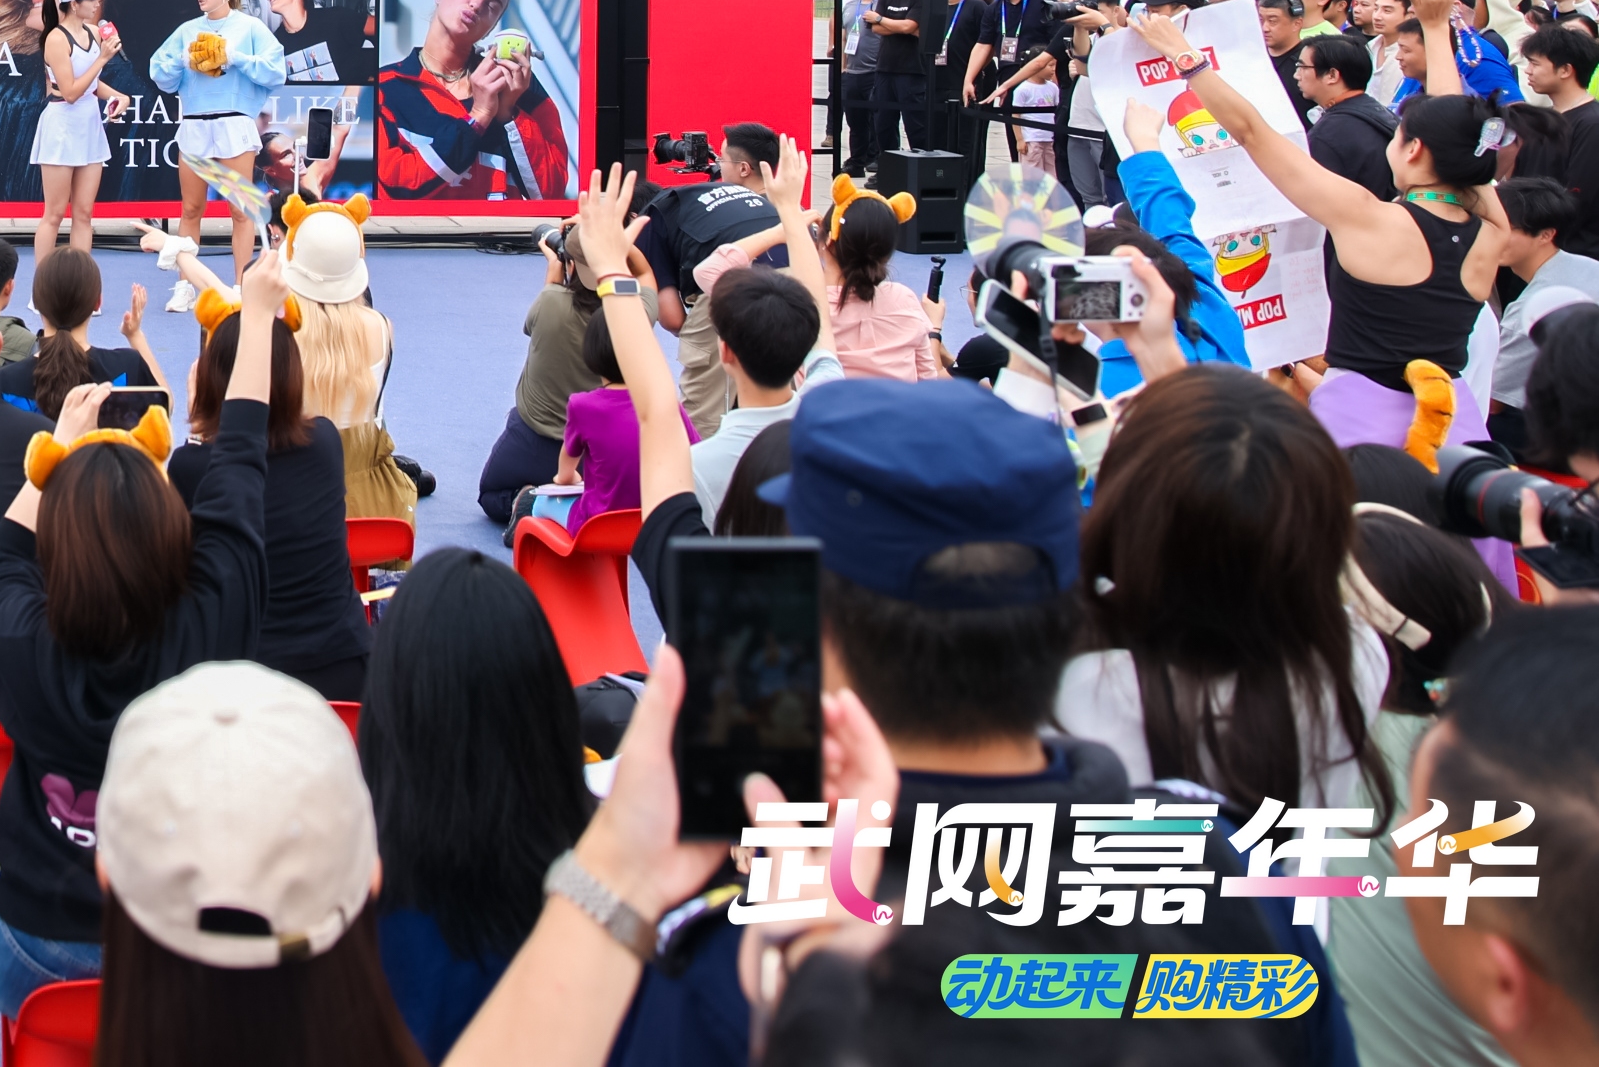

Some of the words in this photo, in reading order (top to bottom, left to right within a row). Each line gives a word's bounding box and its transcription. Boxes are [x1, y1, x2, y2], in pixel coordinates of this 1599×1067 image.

[1139, 60, 1169, 83] POP
[705, 194, 736, 212] OFFICIAL
[744, 198, 763, 208] 26
[1256, 298, 1283, 322] POP
